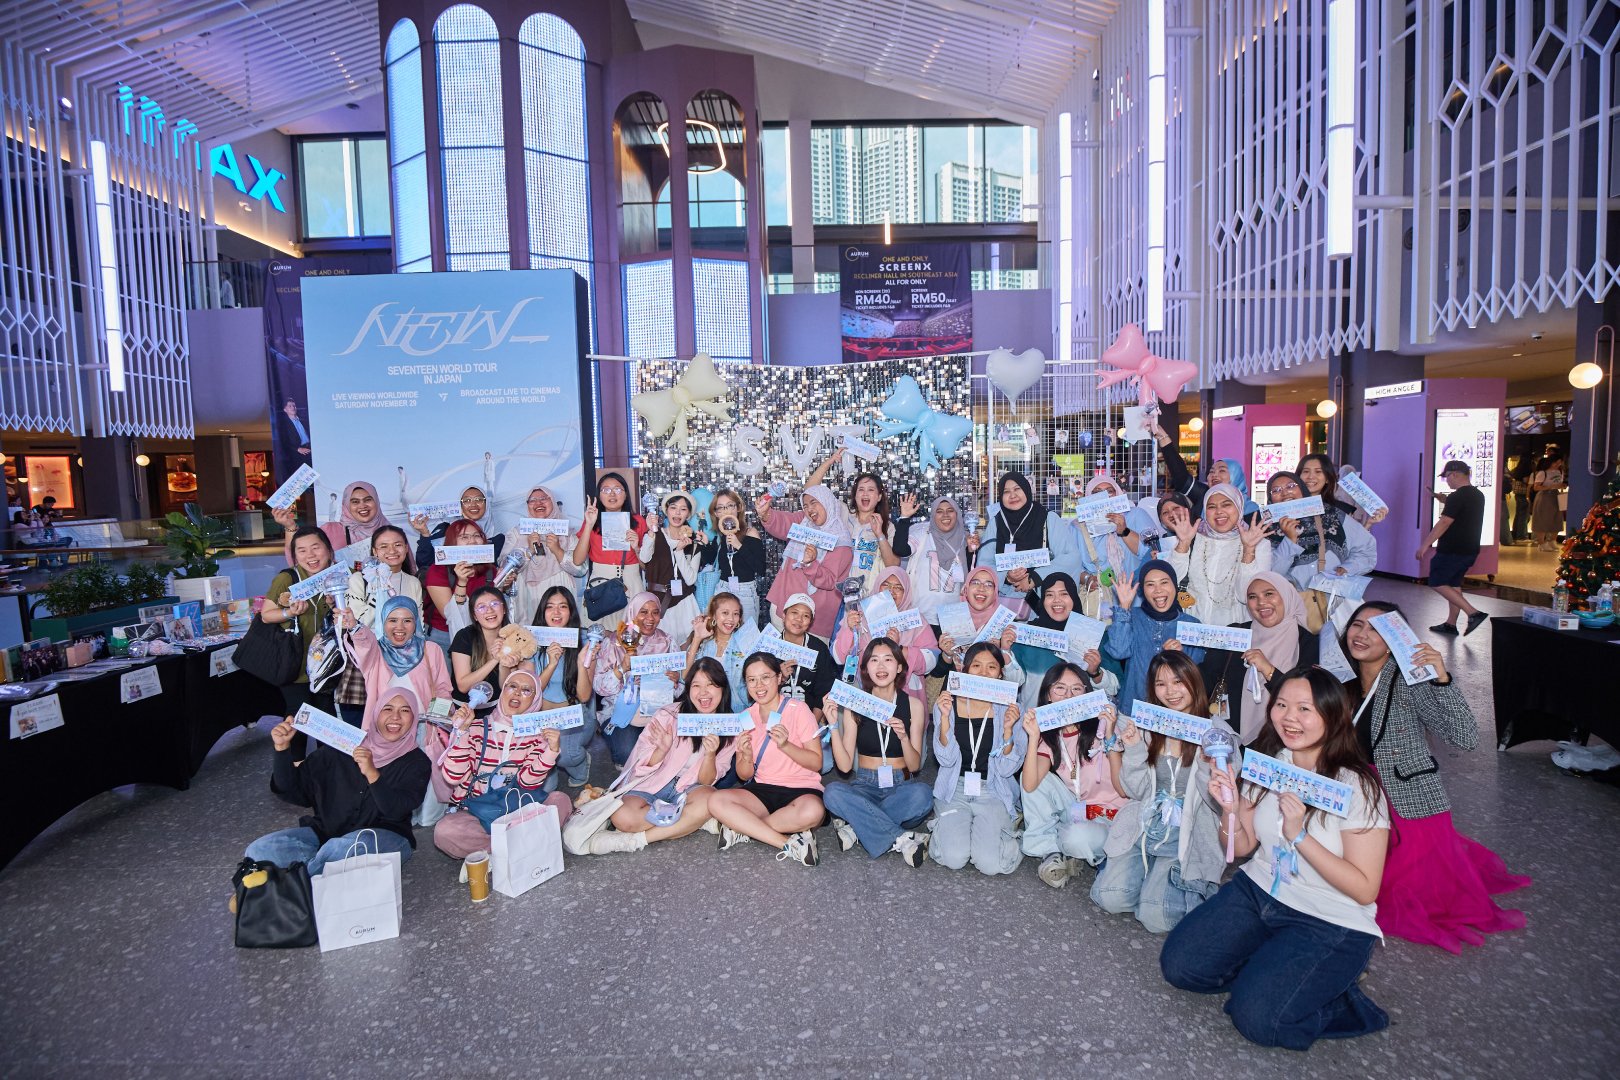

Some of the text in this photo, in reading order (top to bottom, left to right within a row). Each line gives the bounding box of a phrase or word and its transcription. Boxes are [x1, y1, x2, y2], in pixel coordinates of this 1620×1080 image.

[879, 263, 931, 271] SCREENX
[387, 362, 497, 375] SEVENTEEN WORLD TOUR
[424, 373, 462, 385] IN JAPAN
[460, 386, 560, 397] BROADCAST LIVE TO CINEMAS
[1375, 383, 1415, 396] HIGH ANGLE
[332, 391, 419, 401] LIVE VIEWING WORLDWIDE
[476, 395, 546, 404] AROUND THE WORLD
[334, 401, 369, 409] SATURDAY
[370, 399, 408, 408] NOVEMBER
[1250, 756, 1346, 798] SEVENTEEN
